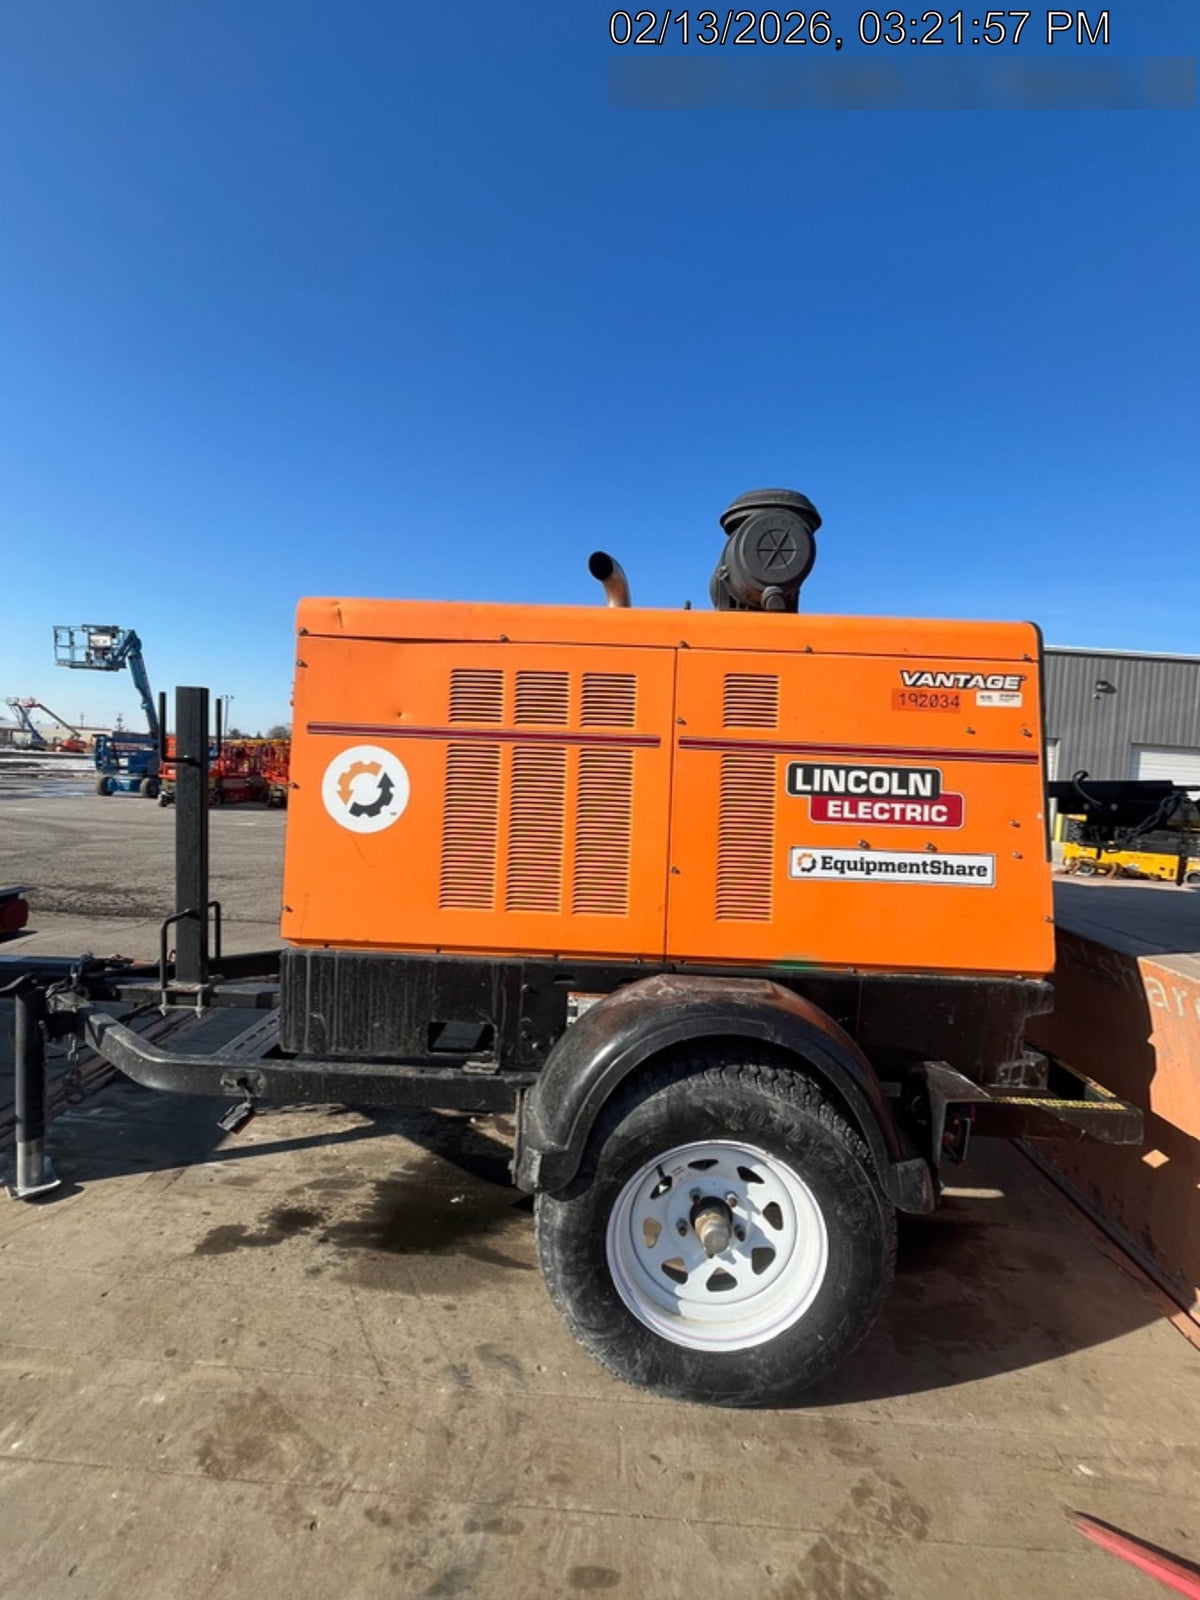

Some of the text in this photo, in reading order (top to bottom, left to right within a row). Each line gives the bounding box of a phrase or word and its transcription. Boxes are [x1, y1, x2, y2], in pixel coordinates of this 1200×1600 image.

[900, 670, 1023, 690] VANTAGE
[899, 692, 960, 708] 192034
[795, 768, 933, 796] LINCOLN
[827, 800, 948, 822] ELECTRIC
[821, 855, 988, 877] EquipmentShare
